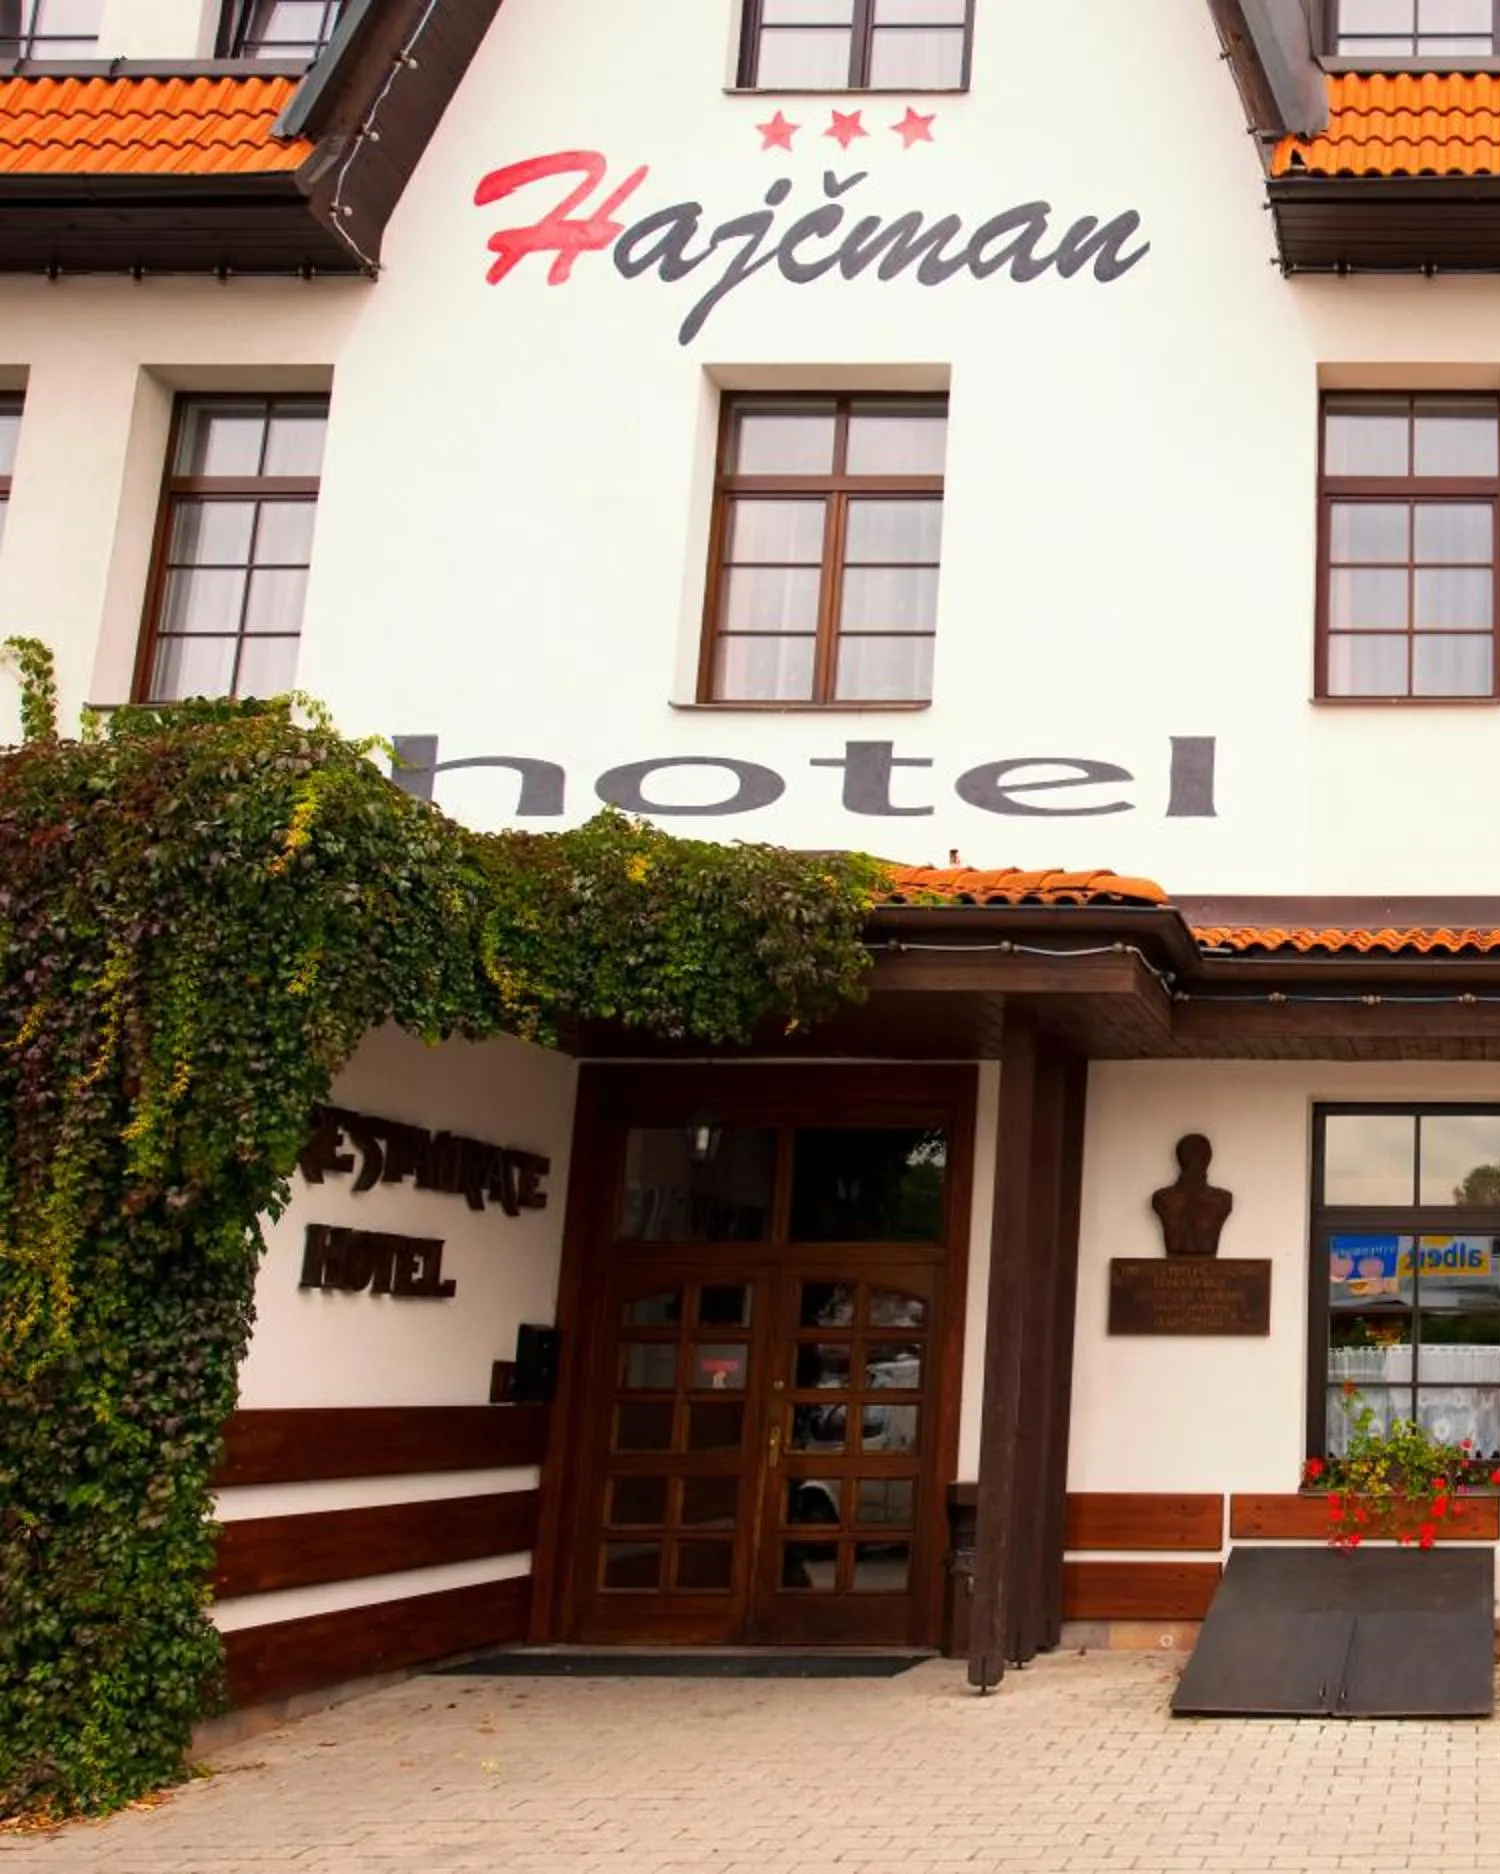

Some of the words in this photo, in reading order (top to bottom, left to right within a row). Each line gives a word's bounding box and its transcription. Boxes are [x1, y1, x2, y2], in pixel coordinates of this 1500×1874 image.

[473, 150, 1151, 346] Hajčman
[391, 734, 1218, 818] hotel
[300, 1223, 457, 1298] HOTEL
